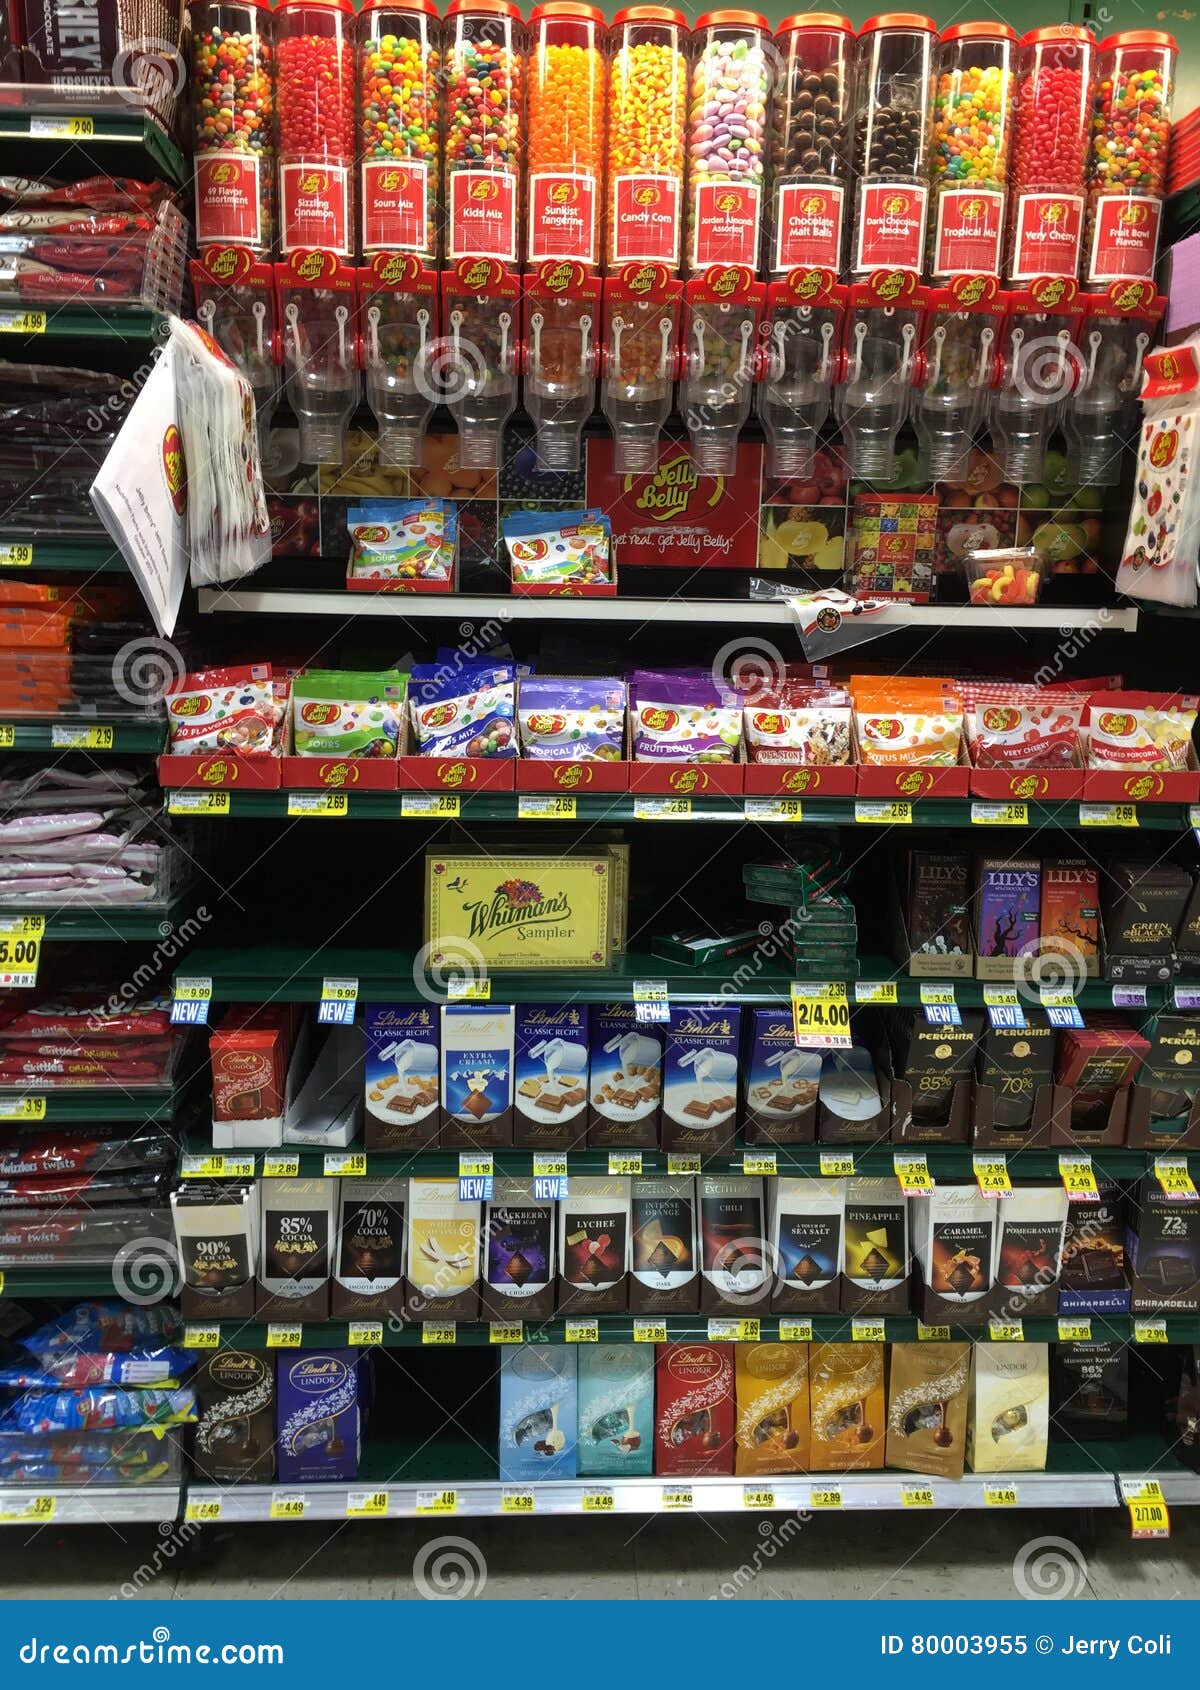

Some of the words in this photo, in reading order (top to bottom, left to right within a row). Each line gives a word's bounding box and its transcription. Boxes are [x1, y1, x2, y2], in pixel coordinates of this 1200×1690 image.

[74, 121, 92, 134] 2.99
[218, 187, 243, 196] Flavor
[204, 196, 248, 205] Assortment
[298, 198, 329, 210] Sizzling
[373, 199, 396, 208] Sours
[398, 199, 414, 209] Mix
[294, 208, 334, 218] Cinnamon
[463, 207, 483, 218] Kids
[486, 208, 503, 219] Mix
[544, 206, 577, 216] Sunkist
[17, 215, 55, 226] Dove
[541, 215, 584, 226] Tangerine
[620, 212, 649, 225] Candy
[788, 216, 834, 227] Chocolate
[866, 217, 884, 226] Dark
[885, 217, 920, 228] Chocolate
[711, 224, 743, 233] Assorted
[789, 227, 811, 237] Malt
[813, 227, 833, 237] Balls
[943, 227, 981, 239] Tropical
[983, 228, 997, 238] Mix
[1109, 228, 1129, 238] Fruit
[1131, 228, 1150, 238] Bowl
[1025, 231, 1047, 242] Very
[1048, 230, 1077, 243] Cherry
[1115, 238, 1144, 247] Flavors
[388, 254, 407, 270] Jelly
[380, 267, 403, 283] Belly
[720, 271, 741, 287] Jelly
[712, 282, 736, 297] Belly
[967, 278, 986, 293] Jelly
[958, 289, 981, 306] Belly
[23, 315, 42, 328] 4.99
[653, 456, 699, 490] Jelly
[636, 484, 690, 521] Belly
[658, 535, 675, 553] Get
[676, 534, 700, 554] Jelly
[176, 728, 188, 737] 20
[190, 716, 235, 736] FLAVORS
[96, 729, 112, 744] 2.19
[458, 727, 476, 740] MIX
[307, 739, 341, 748] SOURS
[639, 743, 664, 752] FRUIT
[1003, 747, 1022, 757] VERY
[1023, 741, 1050, 755] CHERRY
[898, 751, 917, 762] MIX
[1126, 749, 1158, 759] POPCORN
[208, 793, 226, 807] 2.69
[439, 797, 457, 811] 2.69
[891, 805, 908, 818] 2.69
[1116, 807, 1133, 820] 2.69
[919, 866, 968, 881] LILY'S
[987, 871, 1039, 887] LILY'S
[1047, 869, 1097, 884] LILY'S
[462, 891, 572, 940] Whitman's
[23, 918, 42, 931] 2.99
[1131, 922, 1170, 931] GREEN
[517, 926, 575, 941] Sampler
[191, 988, 211, 999] 9.99
[336, 989, 356, 999] 9.99
[829, 983, 846, 997] 2.39
[935, 994, 953, 1004] 3.49
[171, 1001, 198, 1023] NEW
[319, 1001, 345, 1023] NEW
[524, 1009, 568, 1026] Lindt
[798, 1003, 849, 1027] 2/4.00
[925, 1006, 951, 1024] NEW
[990, 1007, 1016, 1026] NEW
[374, 1010, 418, 1026] Lindt
[524, 1027, 554, 1036] CLASSIC
[555, 1028, 580, 1036] RECIPE
[675, 1018, 718, 1035] Lindt
[374, 1029, 405, 1037] CLASSIC
[406, 1029, 431, 1037] RECIPE
[918, 1032, 975, 1041] PERUGINA
[995, 1028, 1051, 1037] PERUGINA
[674, 1037, 705, 1046] CLASSIC
[705, 1038, 731, 1046] RECIPE
[919, 1075, 952, 1091] 85%
[1001, 1077, 1034, 1094] 70%
[26, 1098, 43, 1113] 3.19
[42, 1159, 76, 1171] twists
[908, 1163, 927, 1173] 2.99
[904, 1175, 926, 1187] 2.49
[719, 1204, 744, 1212] CHILI
[358, 1208, 389, 1227] 70%
[849, 1212, 901, 1221] PINEAPPLE
[280, 1216, 313, 1234] 85%
[576, 1219, 616, 1229] LYCHEE
[1163, 1217, 1188, 1231] 72%
[357, 1227, 388, 1236] COCOA
[791, 1227, 806, 1236] SEA
[807, 1227, 830, 1236] SALT
[943, 1227, 984, 1236] CARAMEL
[1006, 1227, 1063, 1235] POMEGRANATE
[196, 1240, 231, 1256] 90%
[1063, 1299, 1126, 1308] GHIRARDELLI
[1134, 1299, 1198, 1309] GHIRARDELLI
[199, 1333, 218, 1343] 2.99
[282, 1333, 300, 1343] 2.89
[436, 1330, 455, 1341] 2.89
[647, 1328, 665, 1338] 2.89
[677, 1352, 706, 1363] Lindt
[218, 1358, 249, 1369] Lindt
[300, 1363, 329, 1374] Lindt
[678, 1365, 712, 1375] LINDOR
[219, 1371, 254, 1381] LINDOR
[300, 1375, 336, 1386] LINDOR
[514, 1496, 533, 1507] 4.39
[997, 1491, 1016, 1501] 4.49
[285, 1502, 304, 1513] 4.49
[1135, 1507, 1163, 1522] 2/7.00
